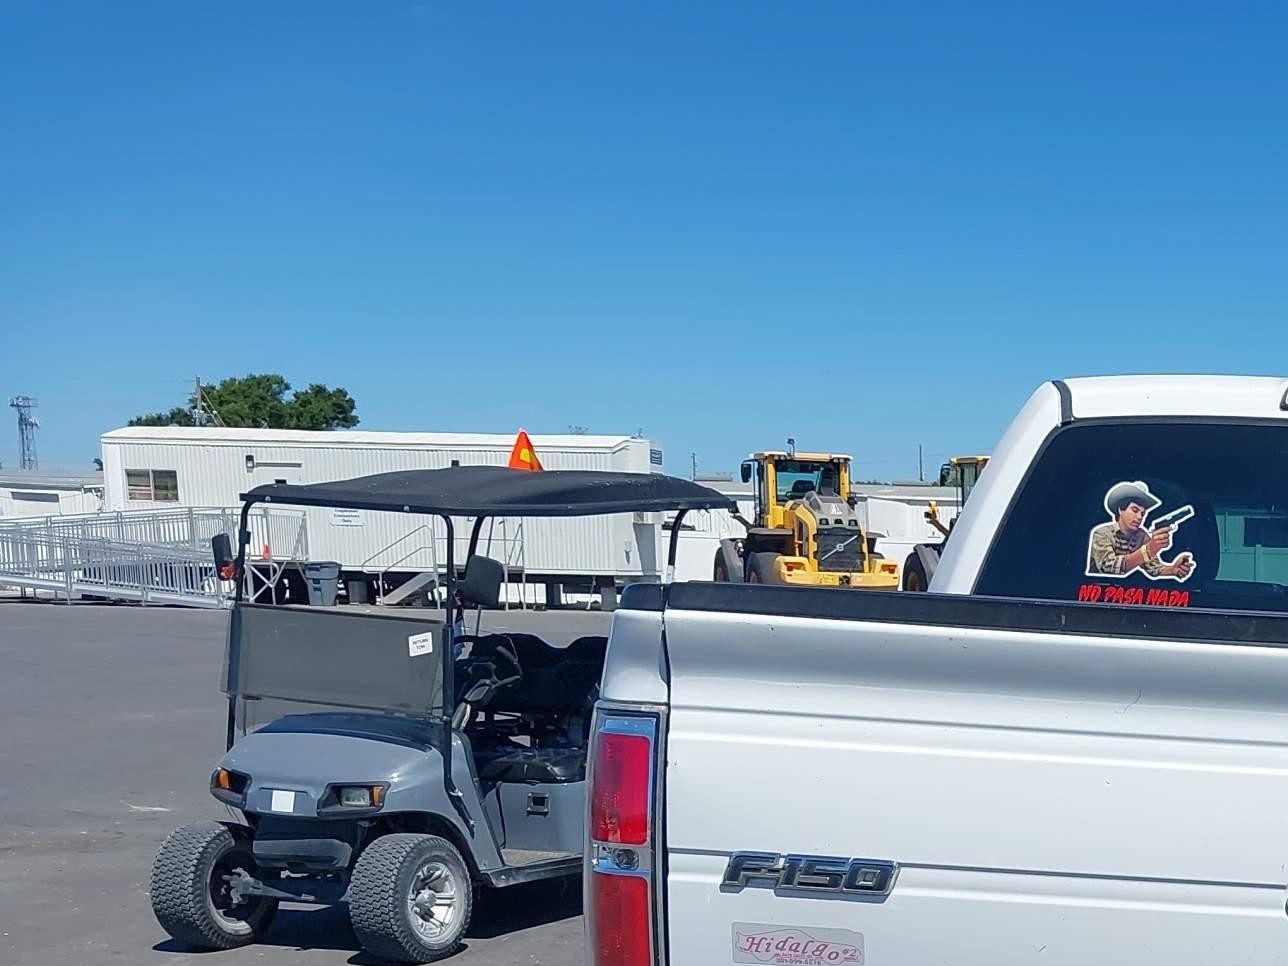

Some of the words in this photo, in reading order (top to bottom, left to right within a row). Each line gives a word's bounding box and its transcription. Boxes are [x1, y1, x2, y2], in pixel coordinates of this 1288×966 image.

[1078, 584, 1102, 603] NO
[1104, 586, 1143, 606] PASA
[1146, 589, 1189, 608] NADA
[743, 936, 840, 961] Hidalgo
